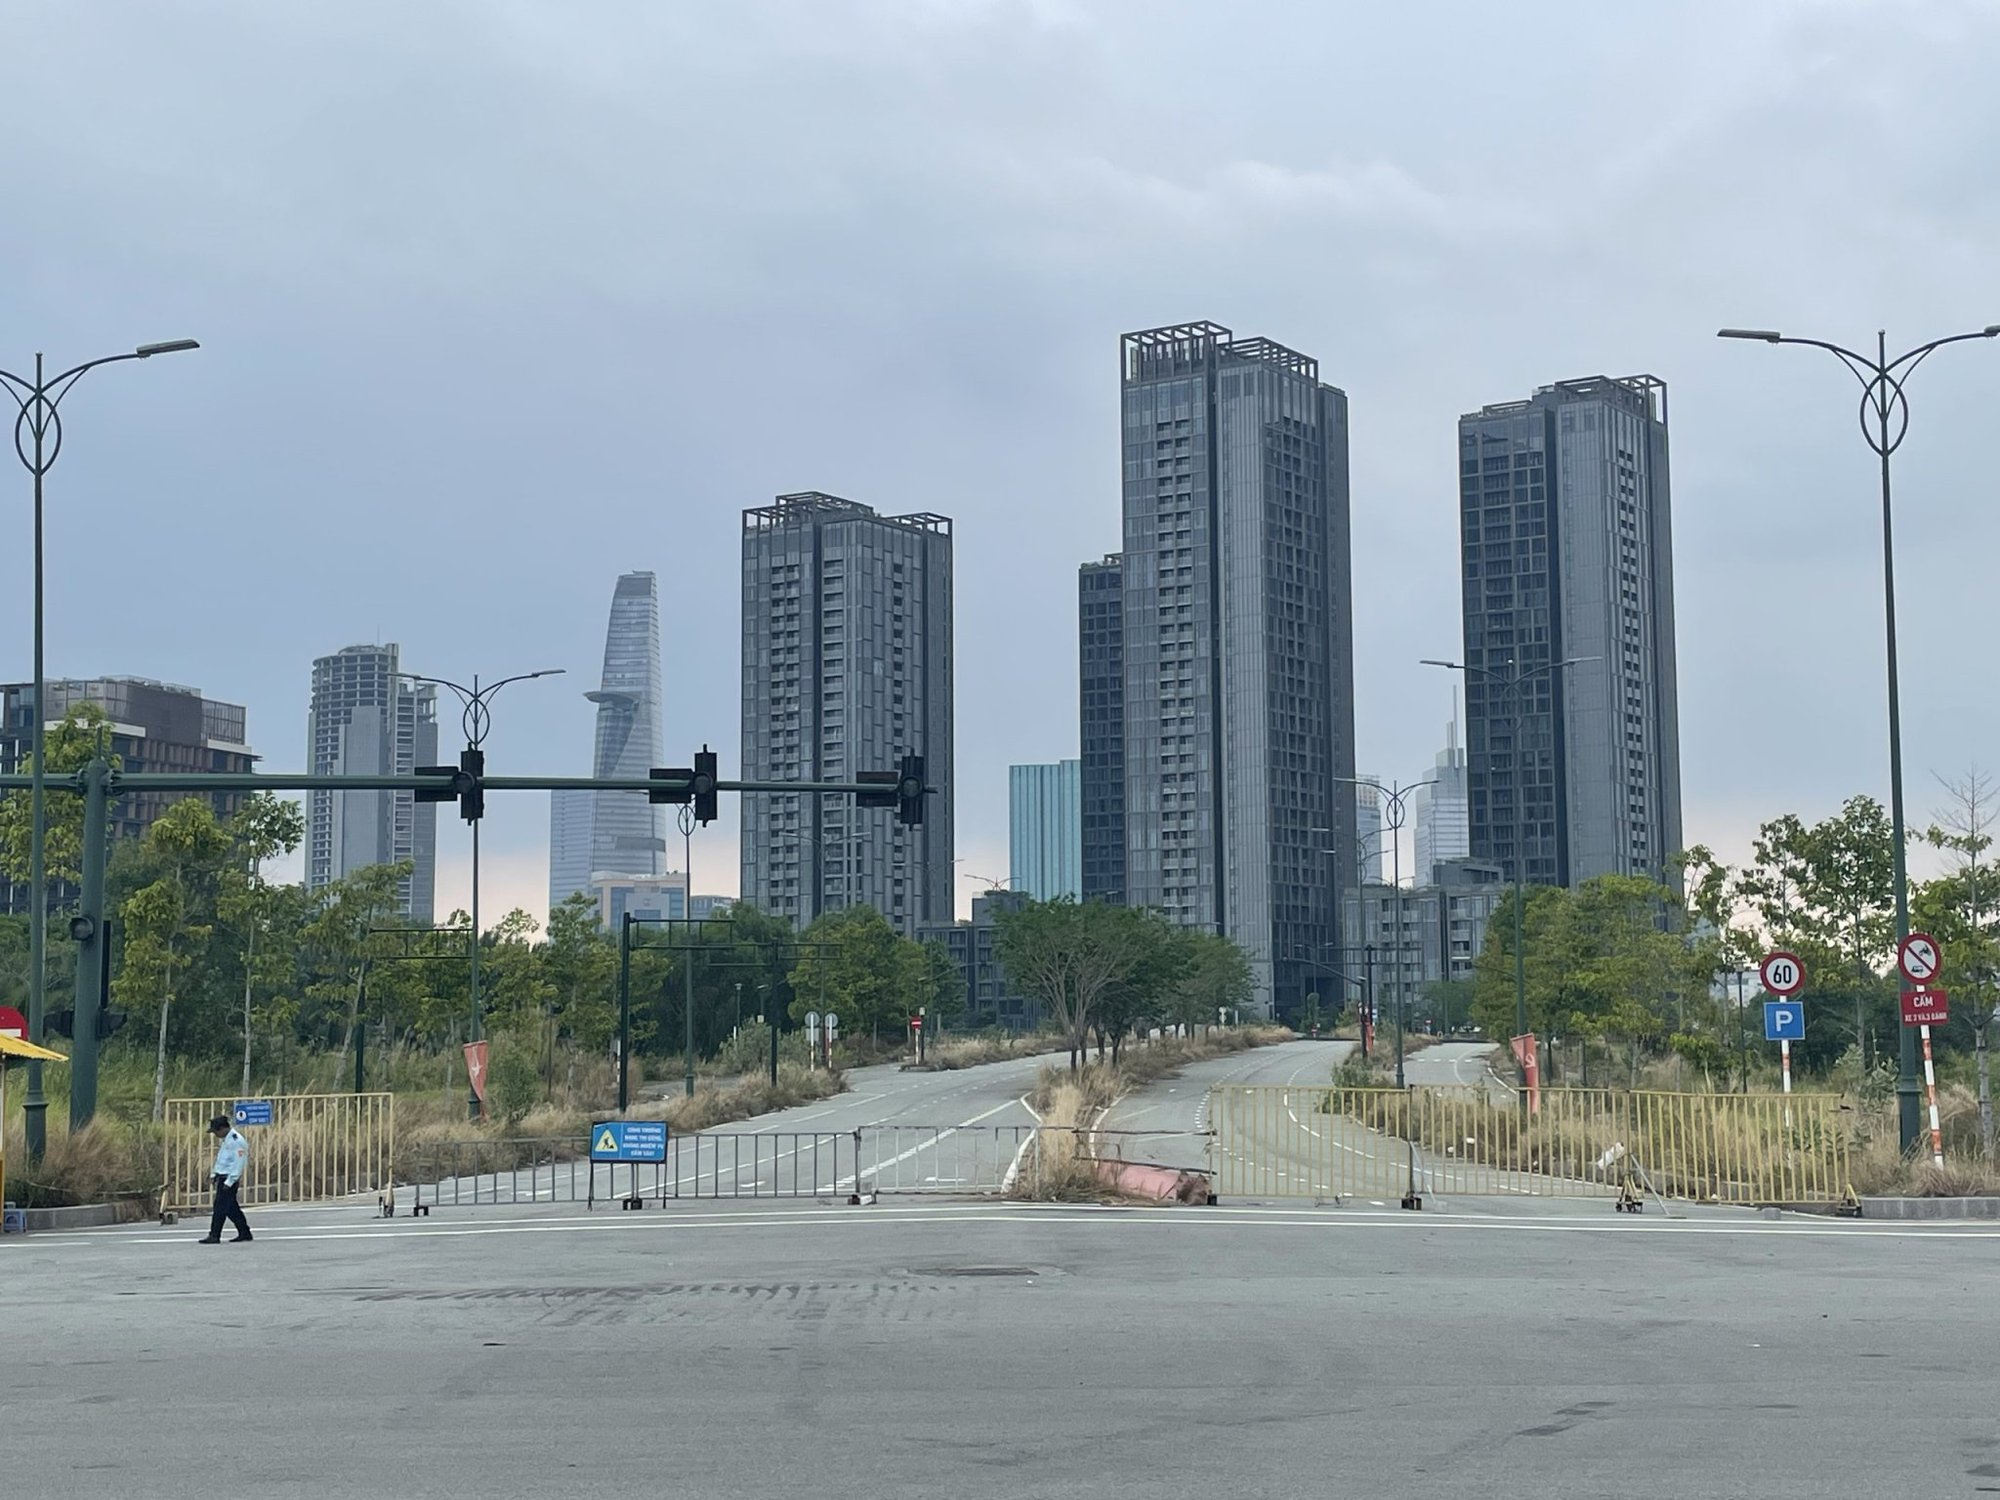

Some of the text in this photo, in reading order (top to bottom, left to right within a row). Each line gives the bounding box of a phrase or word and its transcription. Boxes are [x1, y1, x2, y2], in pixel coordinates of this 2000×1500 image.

[1773, 964, 1792, 984] 60
[1913, 993, 1934, 1008] CẤM
[1775, 1010, 1793, 1032] P
